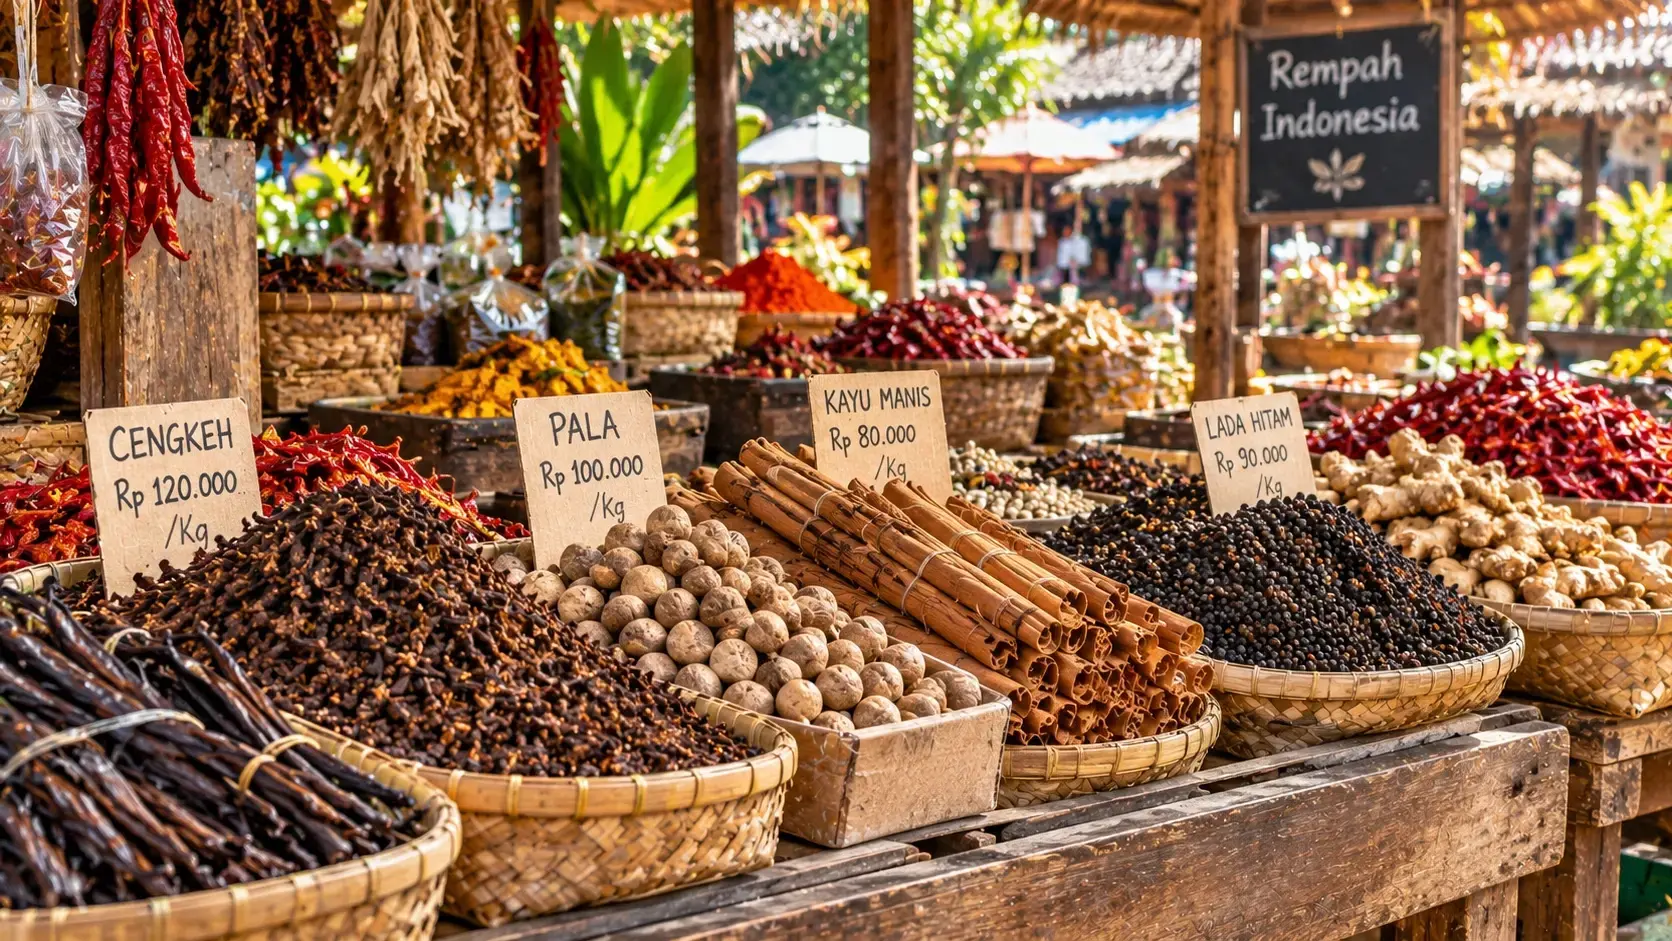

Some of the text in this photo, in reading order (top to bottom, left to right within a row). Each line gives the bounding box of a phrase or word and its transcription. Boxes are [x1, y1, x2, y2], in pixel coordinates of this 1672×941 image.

[1267, 39, 1403, 99] Rempah
[1260, 96, 1421, 141] Indonesia
[824, 386, 931, 415] KAYU MANIS
[109, 417, 233, 462] CENGKEH
[549, 409, 620, 446] PALA
[829, 424, 916, 458] Rp 80.000
[1205, 406, 1293, 440] LADA HITAM
[539, 454, 643, 496] Rp 100.000
[874, 454, 907, 483] /Kg
[1214, 444, 1288, 479] Rp 90.000
[113, 470, 237, 518] Rp 120.000
[1256, 473, 1283, 499] /Kg
[589, 491, 625, 524] /Kg
[165, 513, 208, 550] /Kg
